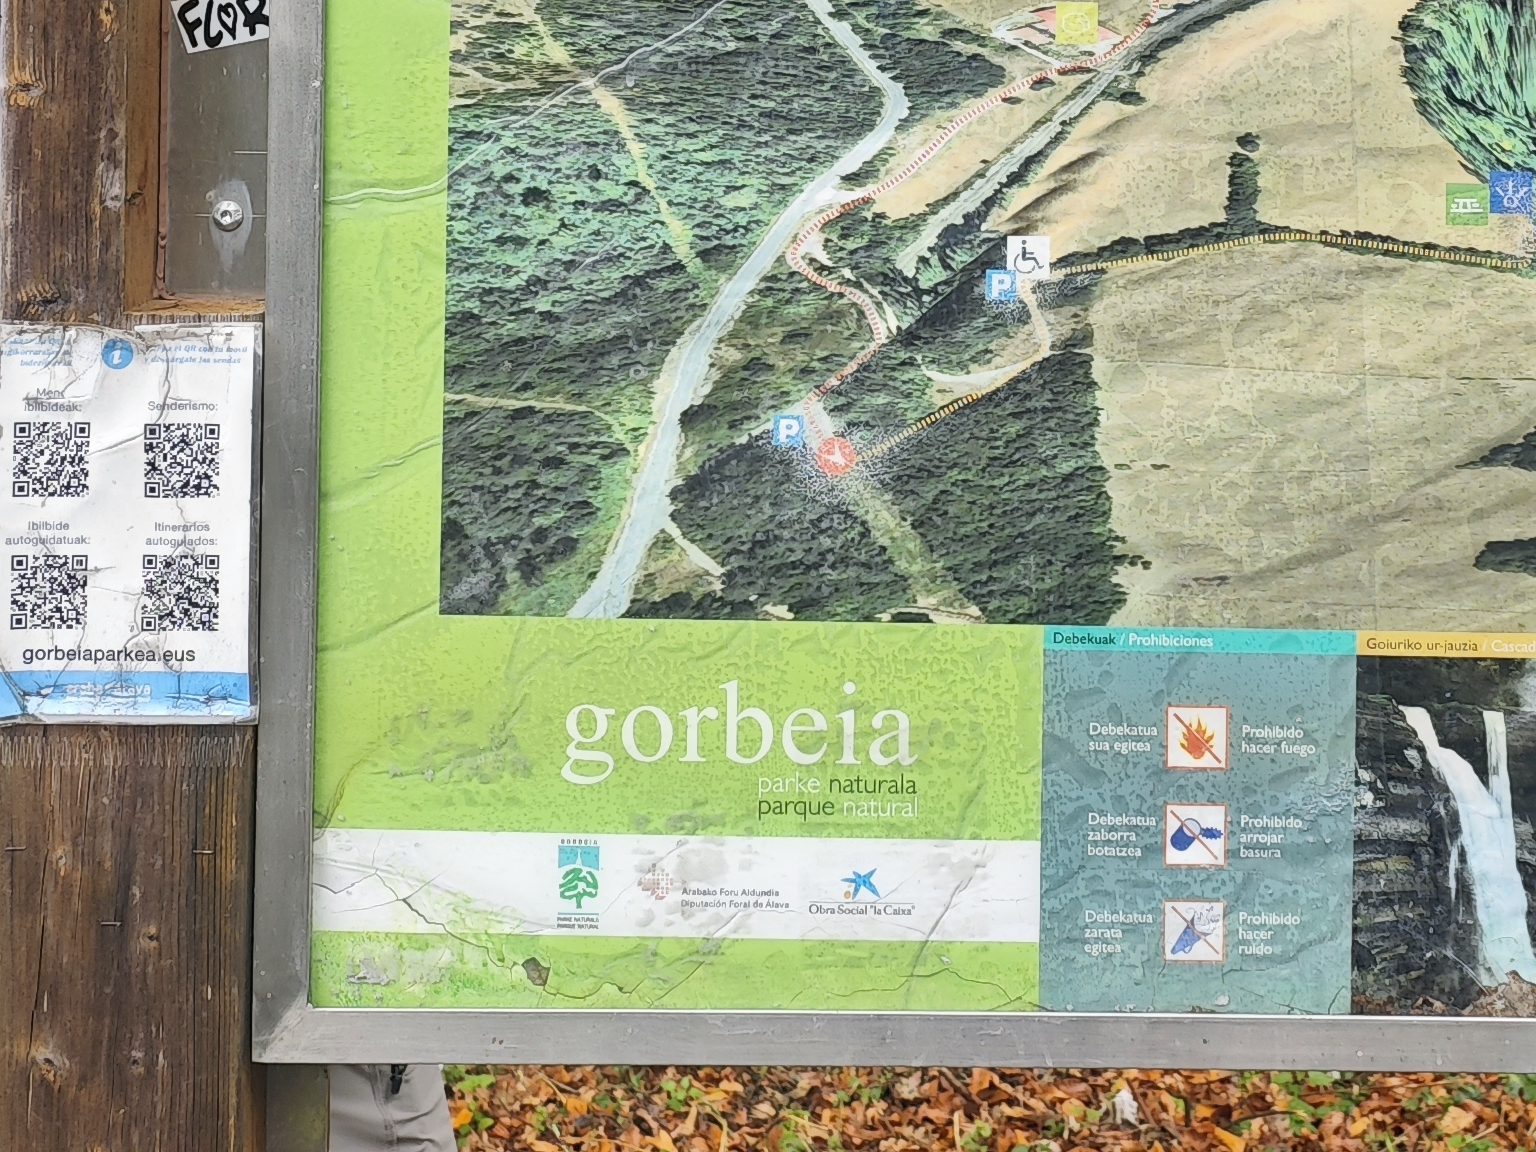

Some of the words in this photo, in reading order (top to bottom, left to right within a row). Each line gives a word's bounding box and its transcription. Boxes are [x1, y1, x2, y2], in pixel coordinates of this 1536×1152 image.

[991, 274, 1012, 297] P
[148, 401, 218, 411] Senderismo:
[778, 419, 800, 442] P
[28, 521, 70, 531] Ibilbide
[154, 522, 210, 532] Itinerarios
[5, 535, 91, 547] autoguidatuak:
[146, 536, 218, 548] autoguiados:
[1053, 632, 1116, 645] Debekuak
[1128, 634, 1214, 647] Prohibiciones
[1366, 638, 1422, 650] Goiuriko
[1427, 640, 1478, 653] ur-jauzia
[23, 646, 196, 664] gorbeiaparkea.eus
[560, 680, 919, 785] gorbeia
[1090, 723, 1158, 736] Debekatua
[1242, 725, 1304, 738] Prohibido
[1088, 740, 1110, 750] sua
[1114, 739, 1150, 754] egitea
[1241, 742, 1277, 754] hacer
[1280, 742, 1316, 757] fuego
[758, 774, 821, 797] parke
[829, 773, 917, 794] naturala
[758, 798, 835, 821] parque
[843, 797, 919, 817] natural
[1088, 813, 1156, 826] Debekatua
[1240, 816, 1302, 829] Prohibido
[1088, 829, 1137, 841] zaborra
[1239, 833, 1284, 846] arrojar
[1087, 845, 1142, 857] botatzea
[1239, 847, 1281, 858] basura
[681, 900, 726, 908] Diputación
[729, 900, 750, 908] Foral
[765, 899, 789, 908] Álava
[809, 904, 835, 915] Obra
[837, 904, 867, 915] Social
[870, 905, 881, 915] "la
[884, 905, 915, 915] Caixa"
[1085, 910, 1153, 924] Debekatua
[1239, 912, 1300, 925] Prohibido
[1085, 928, 1123, 939] zarata
[1239, 928, 1274, 941] hacer
[1084, 943, 1121, 956] egitea
[1239, 944, 1273, 955] ruido
